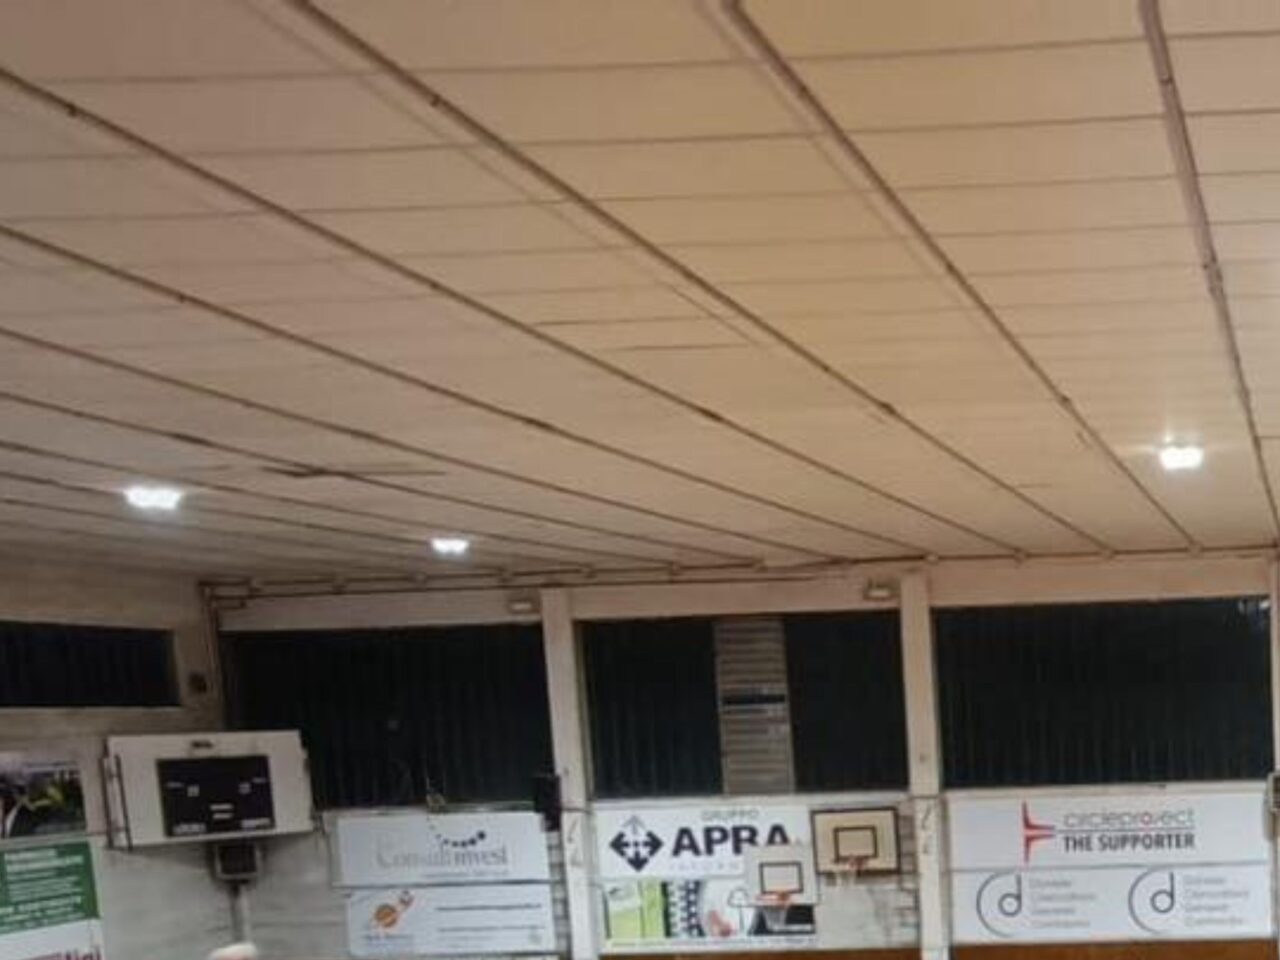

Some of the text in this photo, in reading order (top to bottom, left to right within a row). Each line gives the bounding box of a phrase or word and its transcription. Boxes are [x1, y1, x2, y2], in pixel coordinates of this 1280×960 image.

[672, 823, 791, 857] APRA
[1063, 833, 1196, 852] THE SUPPORTER
